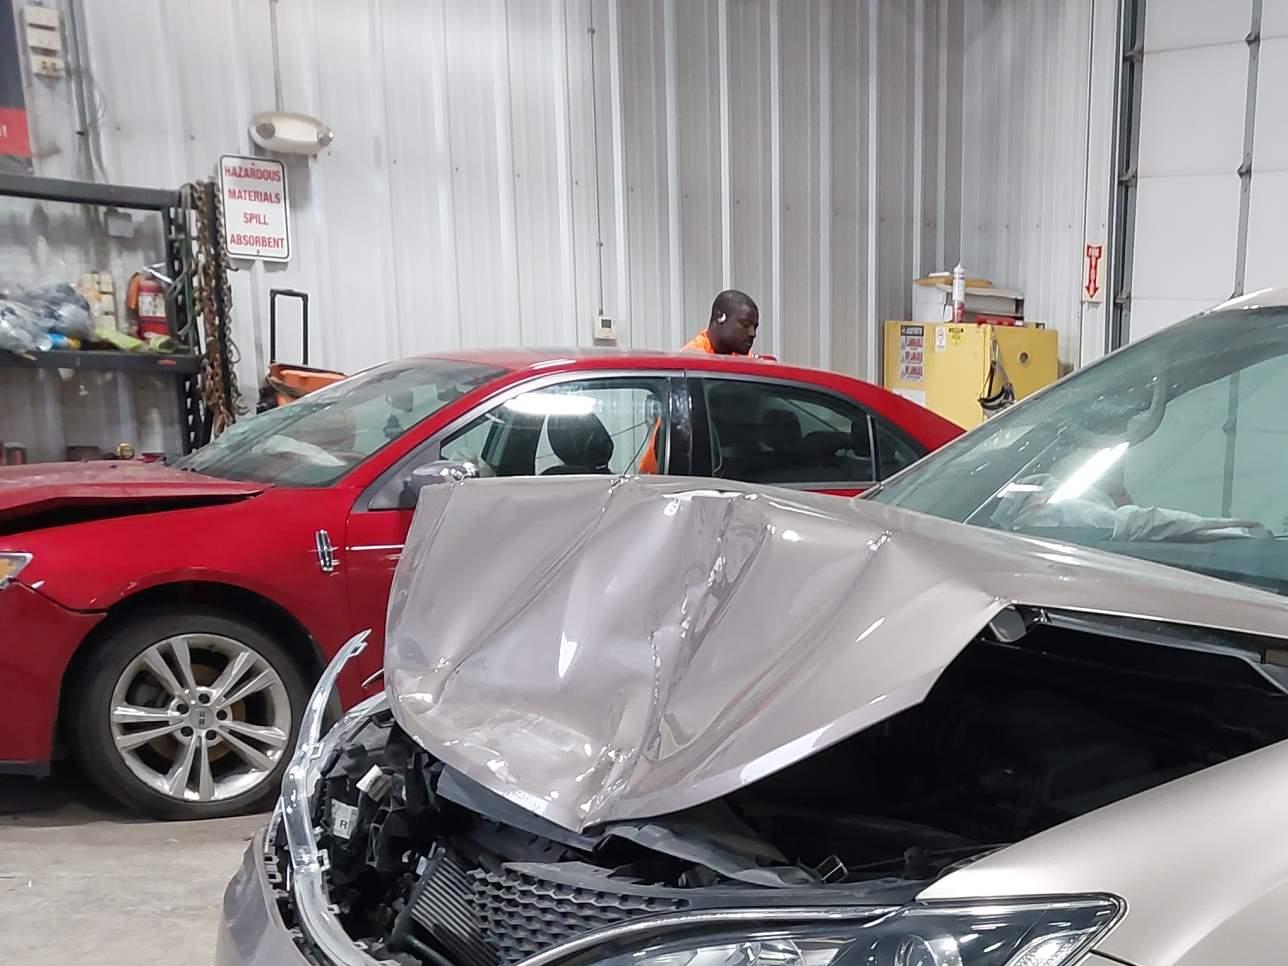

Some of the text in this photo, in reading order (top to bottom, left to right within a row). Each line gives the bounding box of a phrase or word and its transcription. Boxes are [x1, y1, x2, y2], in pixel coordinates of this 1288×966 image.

[224, 165, 281, 182] HAZARDOUS
[228, 188, 281, 204] MATERIALS
[243, 212, 269, 226] SPILL
[230, 234, 284, 249] ABSORBENT
[340, 820, 348, 830] R
